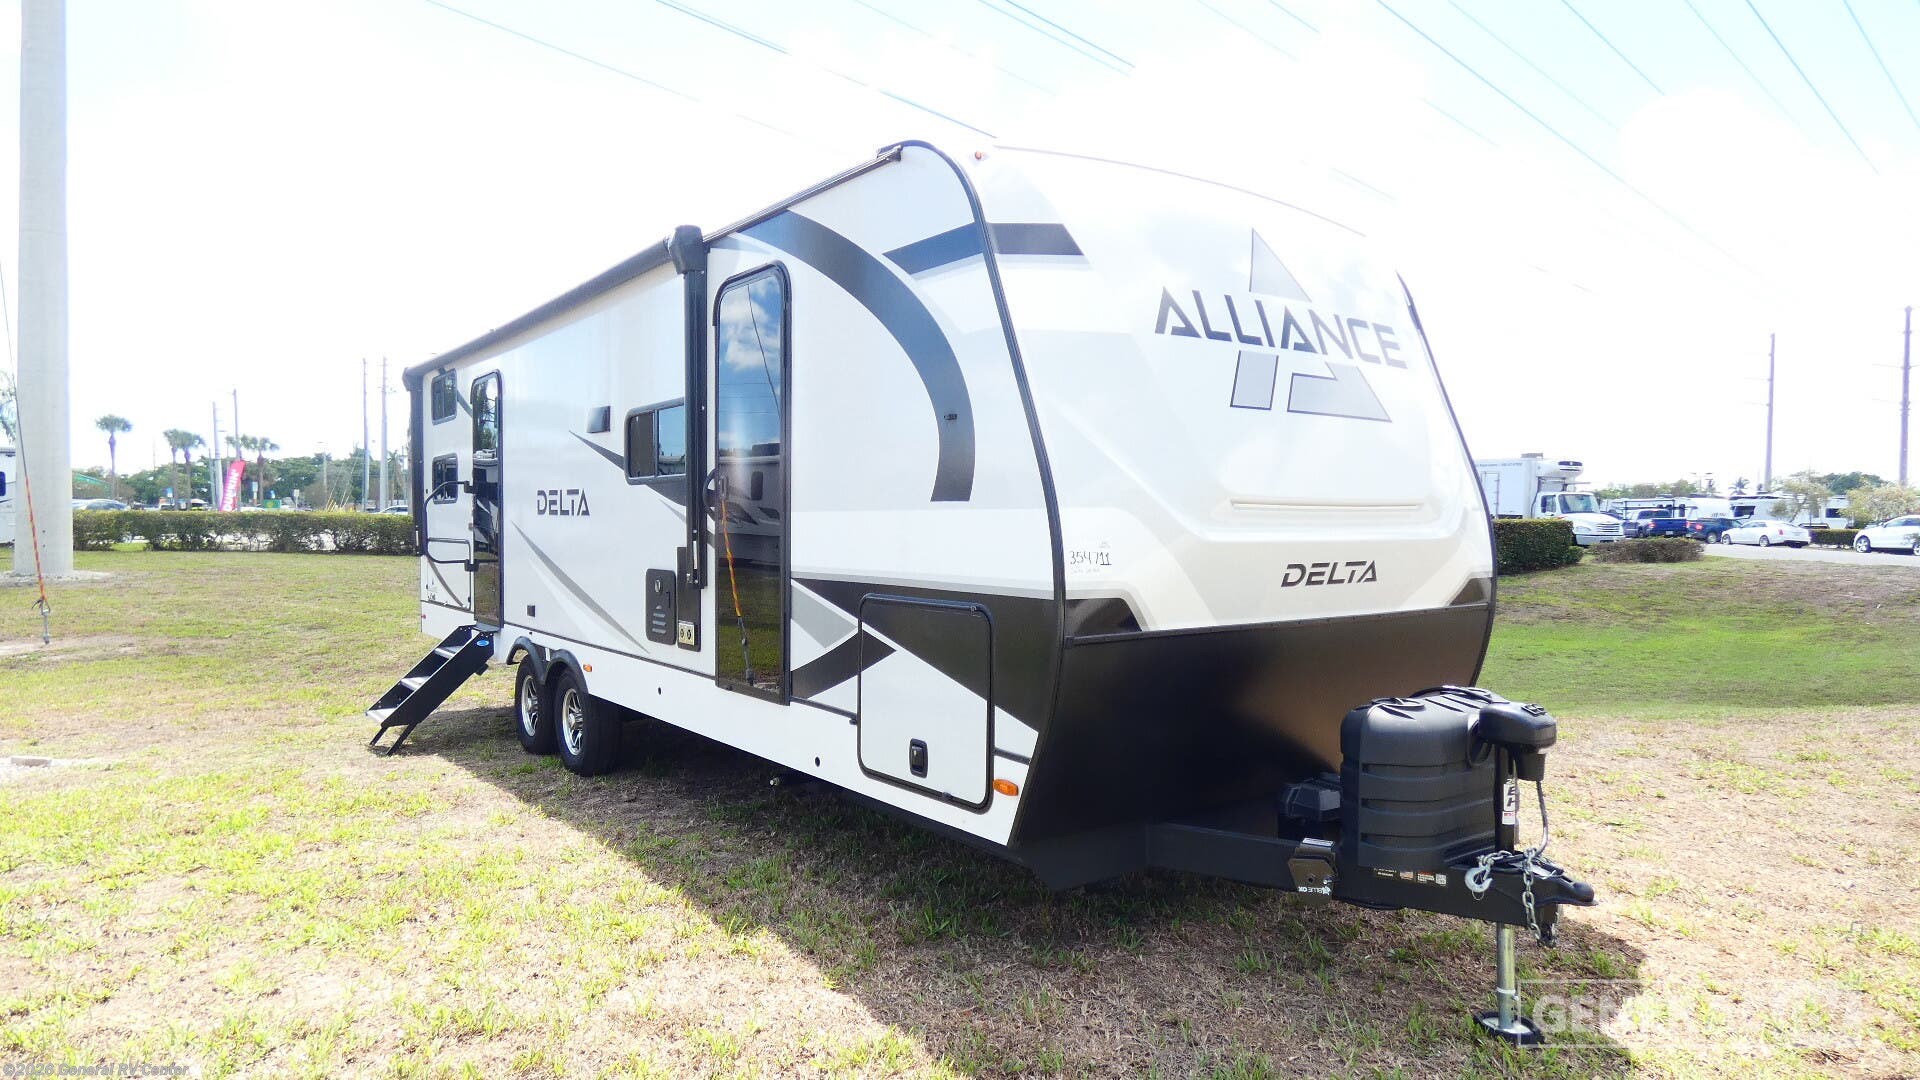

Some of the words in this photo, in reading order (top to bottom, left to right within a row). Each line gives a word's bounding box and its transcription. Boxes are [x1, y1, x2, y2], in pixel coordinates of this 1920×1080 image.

[1155, 286, 1408, 369] ALLIANCE
[537, 488, 590, 516] DELTA
[1281, 560, 1378, 587] DELTA
